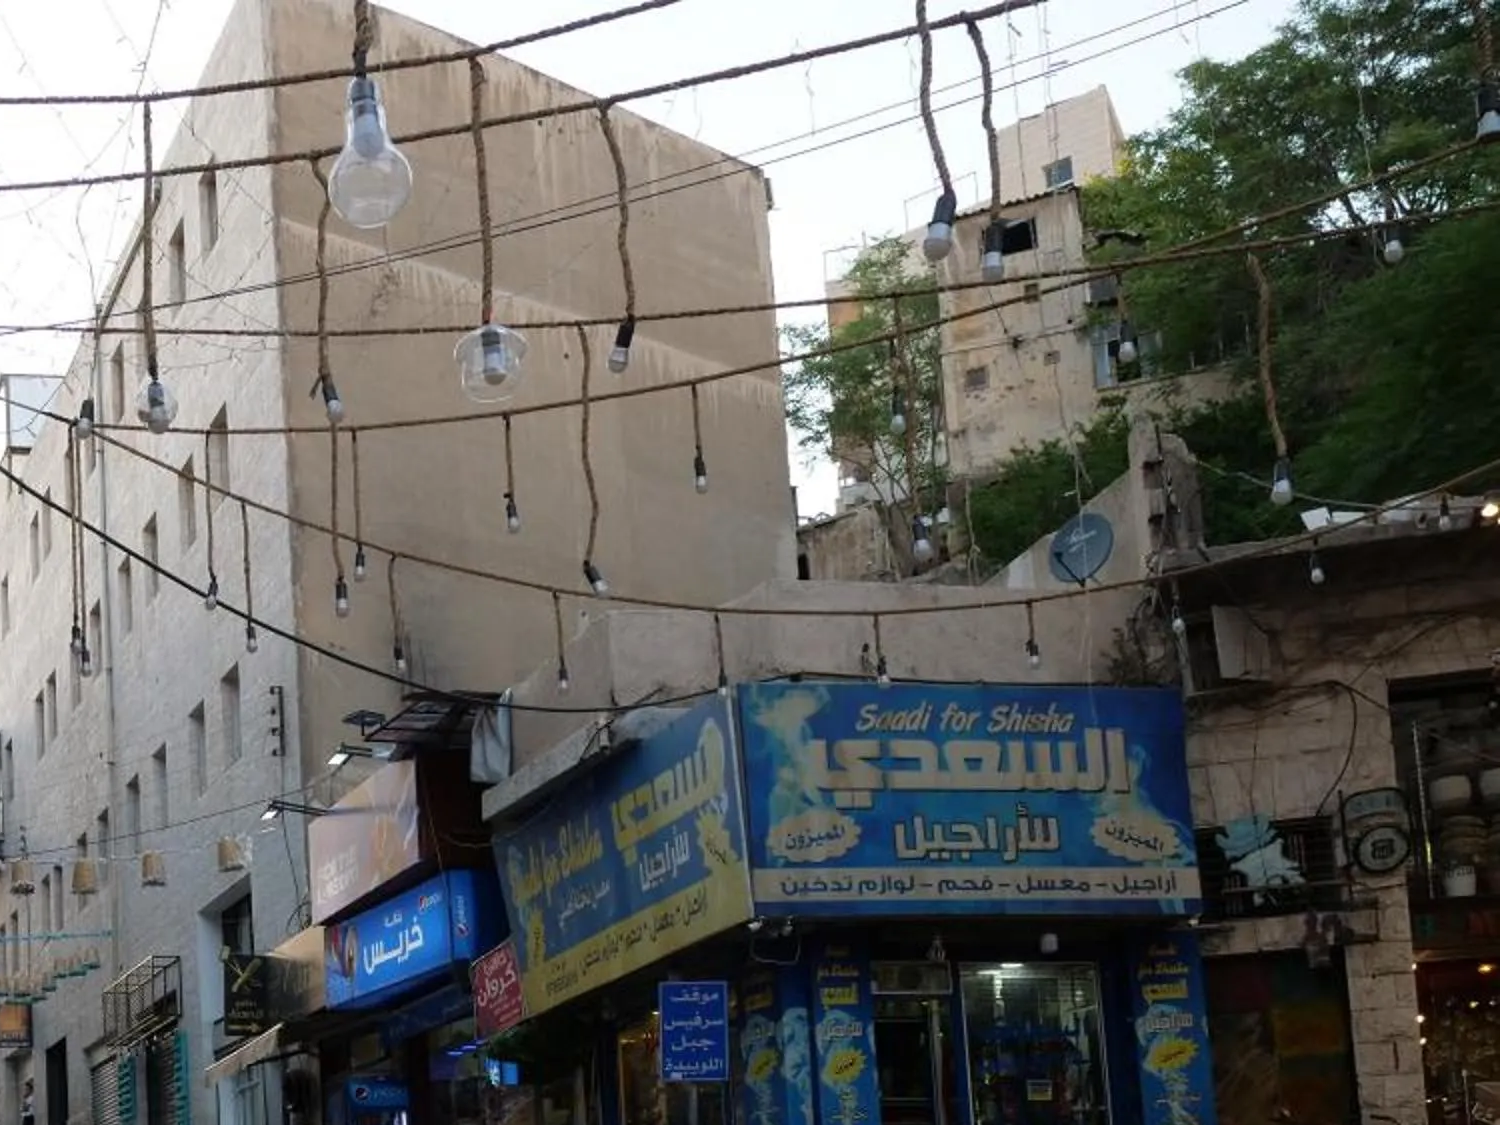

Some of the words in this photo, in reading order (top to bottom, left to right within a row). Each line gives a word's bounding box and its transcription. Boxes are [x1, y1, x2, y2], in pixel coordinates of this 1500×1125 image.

[855, 701, 932, 733] Saadi
[940, 701, 980, 733] for
[987, 701, 1074, 733] Shisha
[808, 726, 1131, 810] السعدي
[894, 801, 1060, 862] للأراجيل
[1016, 874, 1091, 897] معسل
[664, 1010, 724, 1031] سرفيس
[671, 1034, 717, 1053] جبل
